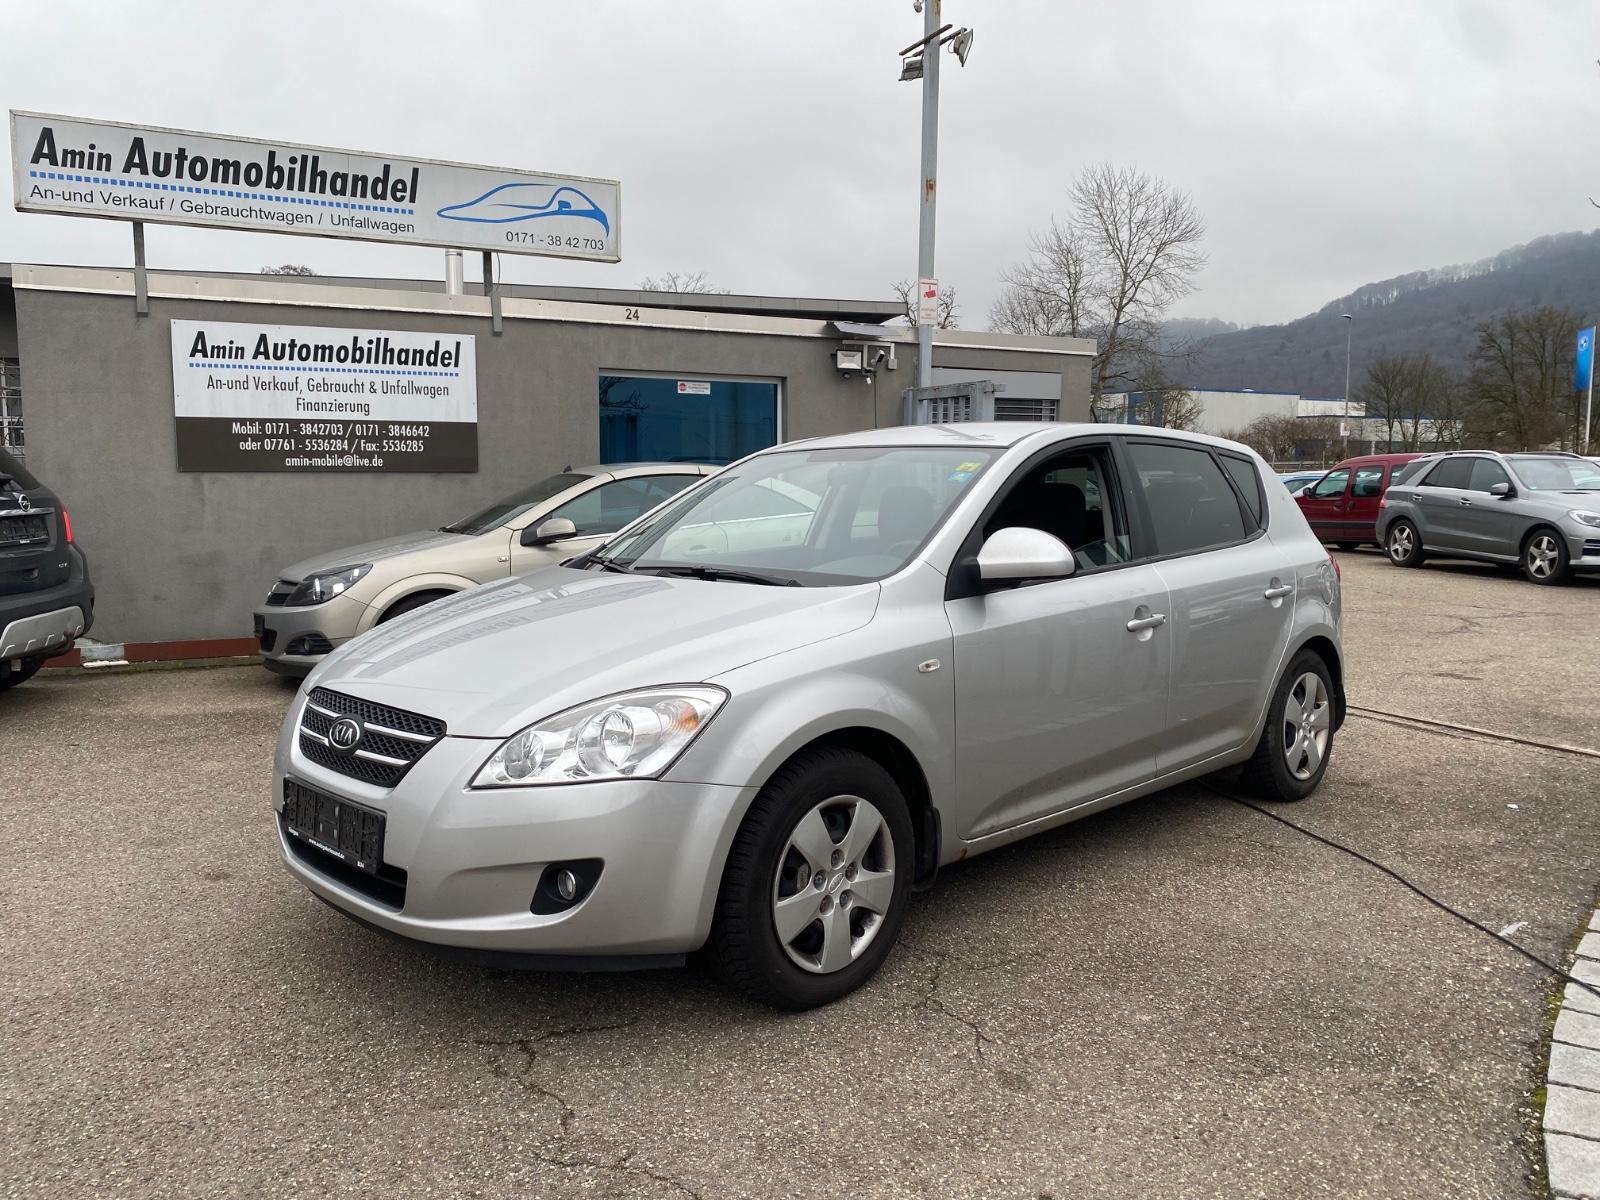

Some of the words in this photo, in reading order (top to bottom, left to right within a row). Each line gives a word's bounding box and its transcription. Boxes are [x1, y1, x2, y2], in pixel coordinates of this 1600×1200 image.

[30, 127, 112, 171] Amin
[122, 137, 419, 203] Automobilhandel
[30, 185, 93, 203] An-und
[100, 191, 165, 210] Verkauf
[180, 200, 313, 225] Gebrauchtwagen
[330, 214, 415, 233] Unfallwagen
[506, 231, 534, 244] 0171
[547, 235, 561, 246] 38
[565, 237, 580, 248] 42
[583, 239, 605, 250] 703
[625, 308, 640, 320] 24
[189, 331, 245, 359] Amin
[252, 333, 461, 368] Automobilhandel
[207, 375, 249, 390] An-und
[253, 376, 303, 394] Verkauf,
[307, 377, 365, 393] Gebraucht
[369, 381, 378, 394] &
[381, 380, 449, 399] Unfallwagen
[296, 397, 370, 416] Finanzierung
[232, 421, 262, 434] Mobil:
[265, 423, 290, 434] 0171
[300, 423, 343, 435] 3842703
[355, 424, 379, 436] 0171
[388, 425, 430, 437] 3846642
[240, 437, 261, 450] oder
[264, 438, 295, 450] 07761
[305, 439, 348, 451] 5536284
[361, 440, 380, 451] Fax:
[382, 440, 424, 452] 5536285
[285, 454, 384, 466] amin-mobile@live.de
[333, 724, 353, 744] KIA
